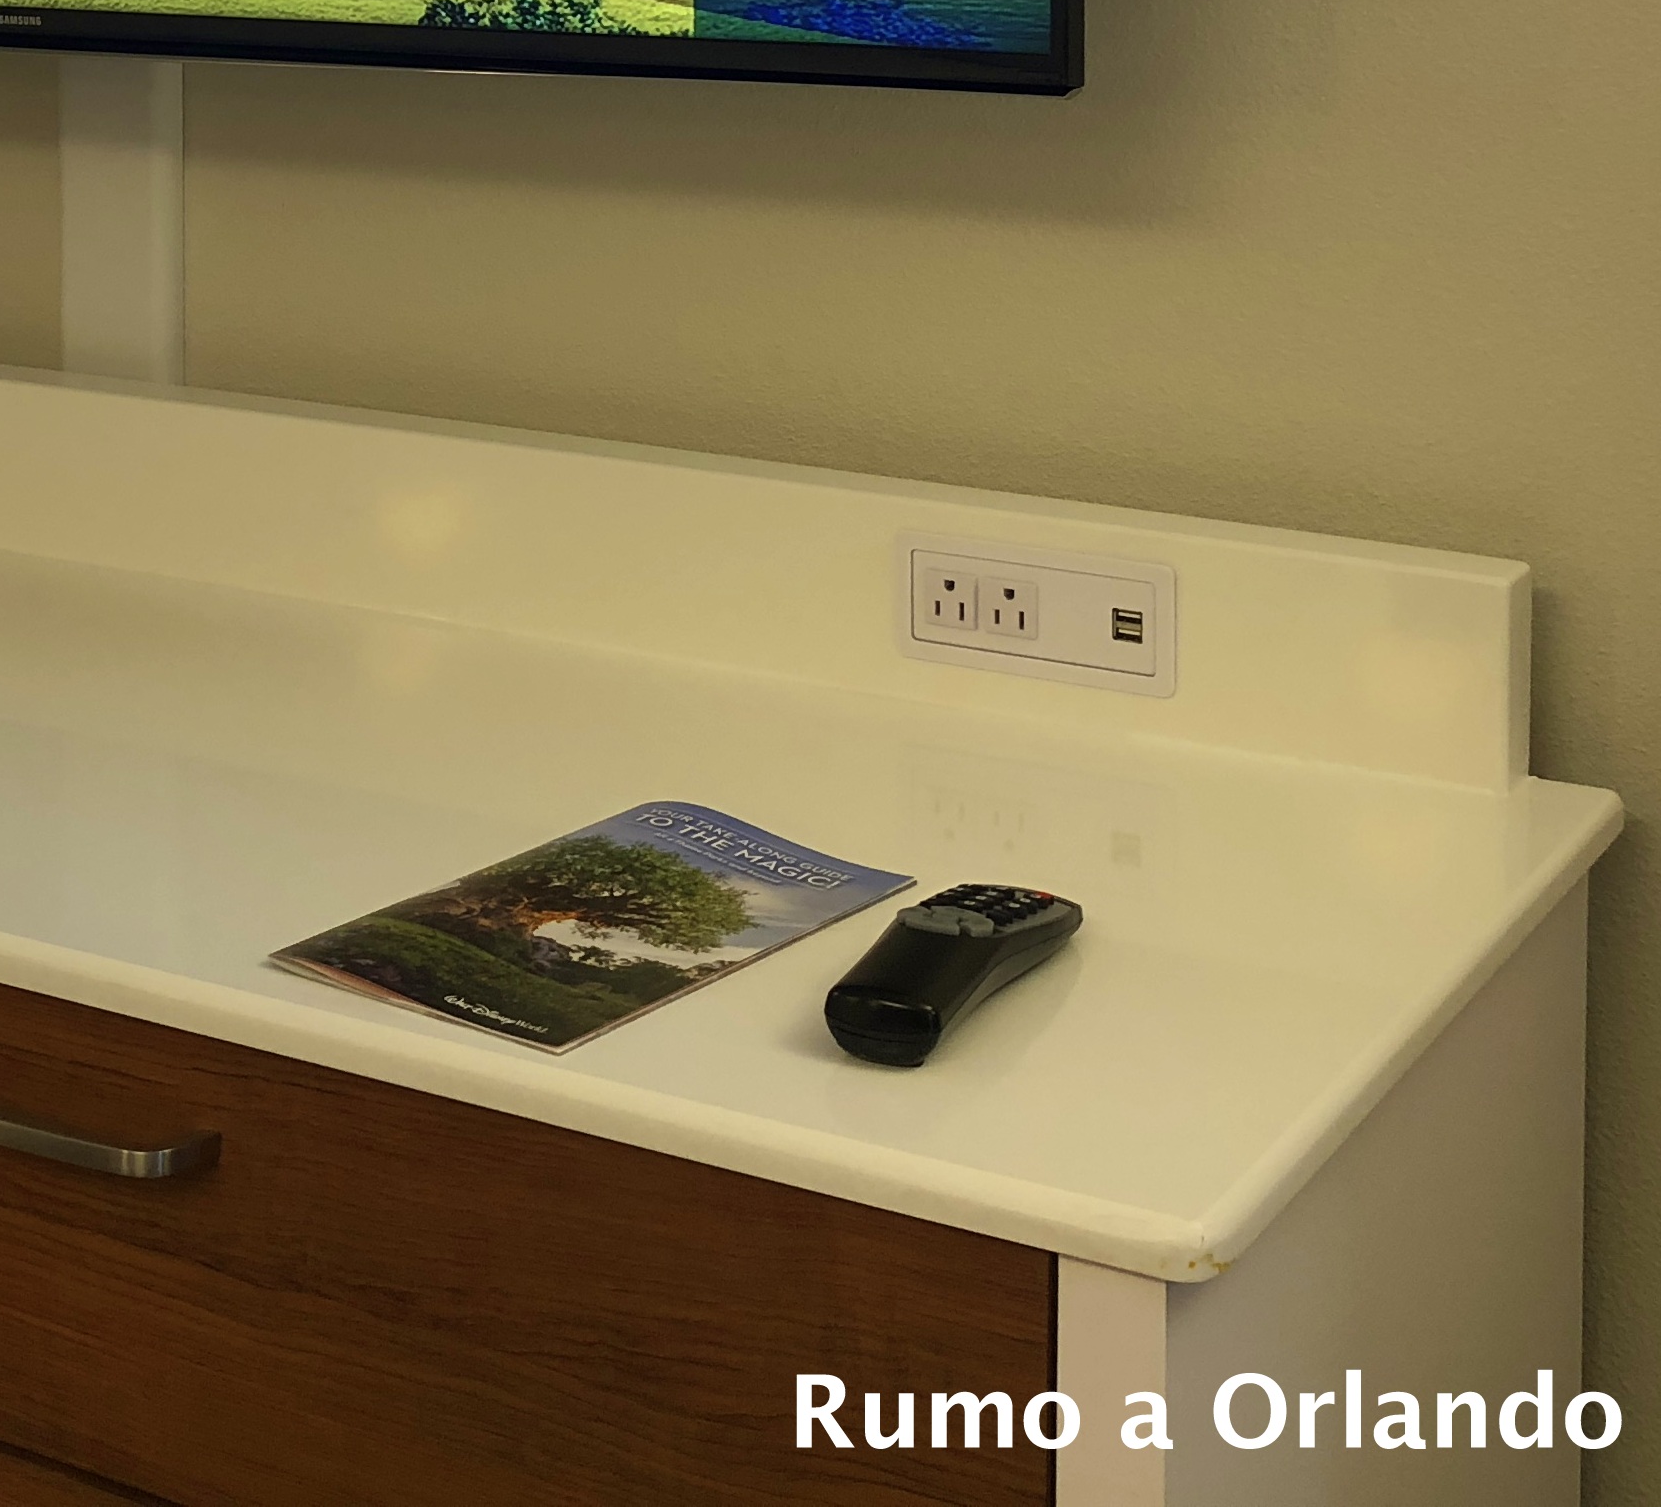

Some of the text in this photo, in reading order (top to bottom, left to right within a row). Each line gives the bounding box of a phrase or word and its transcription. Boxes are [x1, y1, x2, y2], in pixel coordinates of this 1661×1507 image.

[636, 813, 842, 890] TO THE MAGIC!
[650, 808, 695, 824] YOUR
[800, 861, 855, 881] GUIDE
